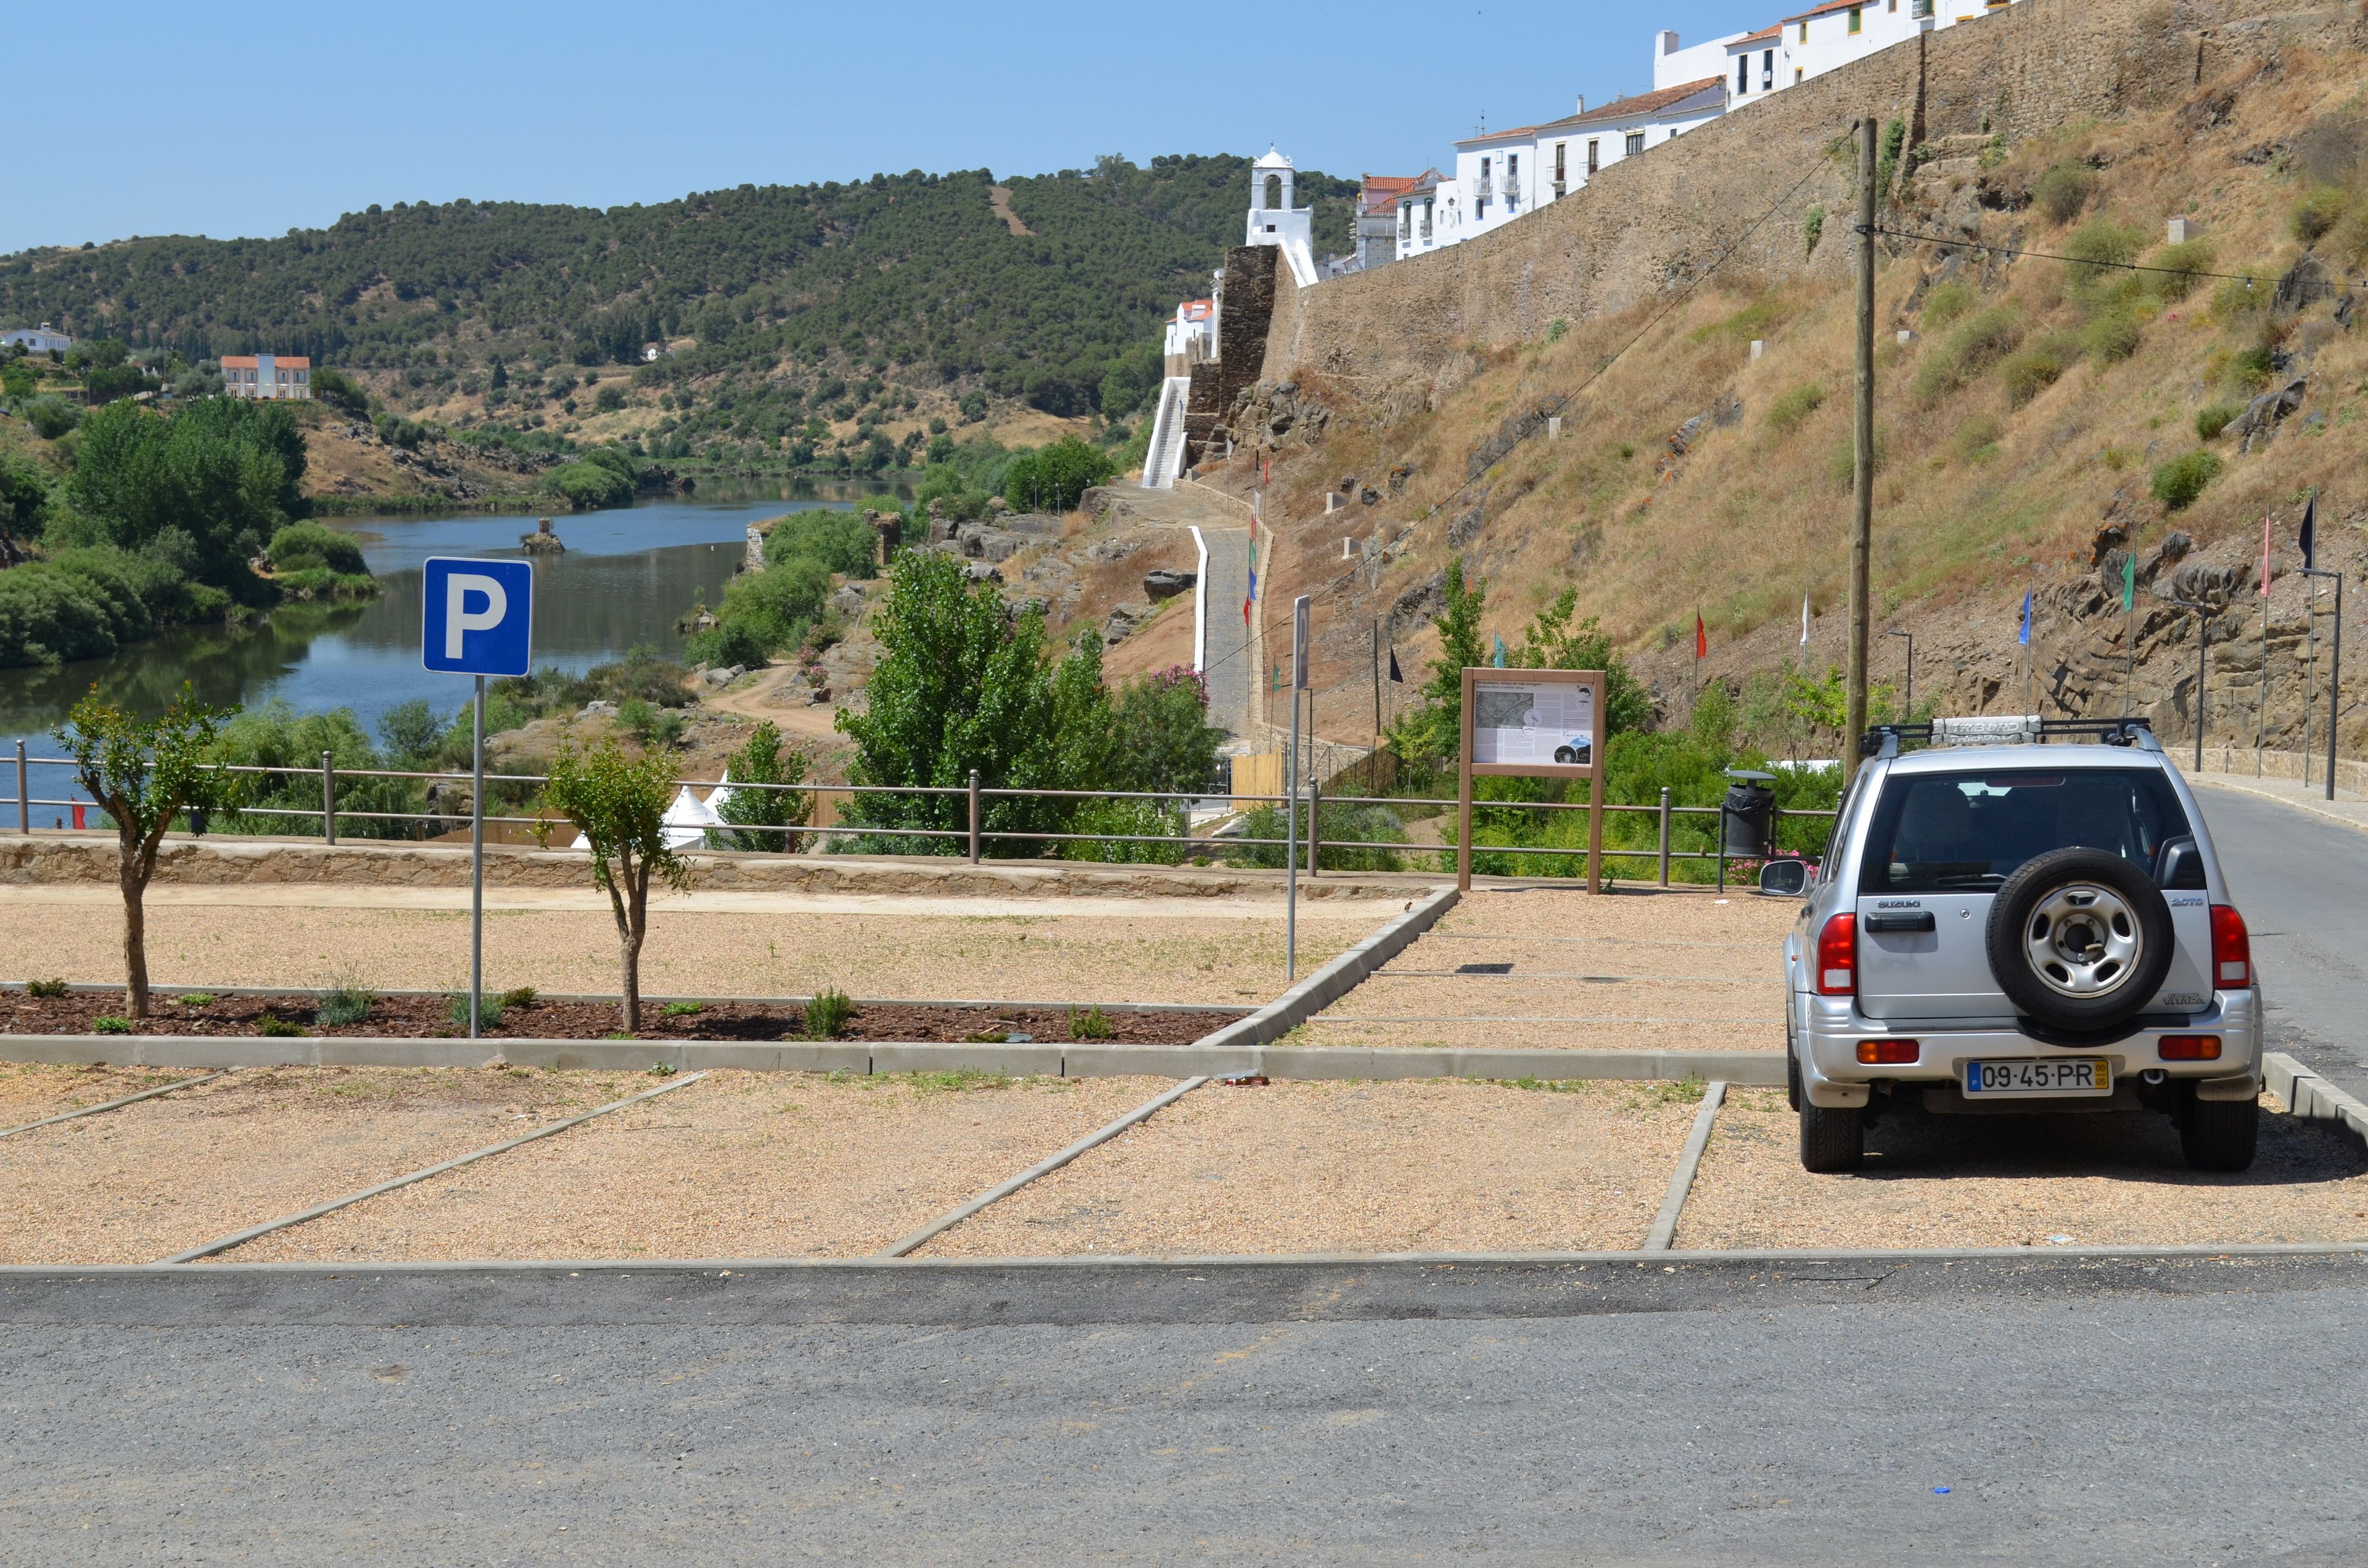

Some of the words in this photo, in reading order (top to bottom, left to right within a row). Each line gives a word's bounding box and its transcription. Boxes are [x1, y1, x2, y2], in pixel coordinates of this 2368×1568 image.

[445, 573, 507, 659] P
[1299, 607, 1307, 681] P
[1951, 721, 2020, 733] TRIBORD
[1877, 900, 1921, 908] SUZUKI
[2163, 997, 2205, 1005] VITARA
